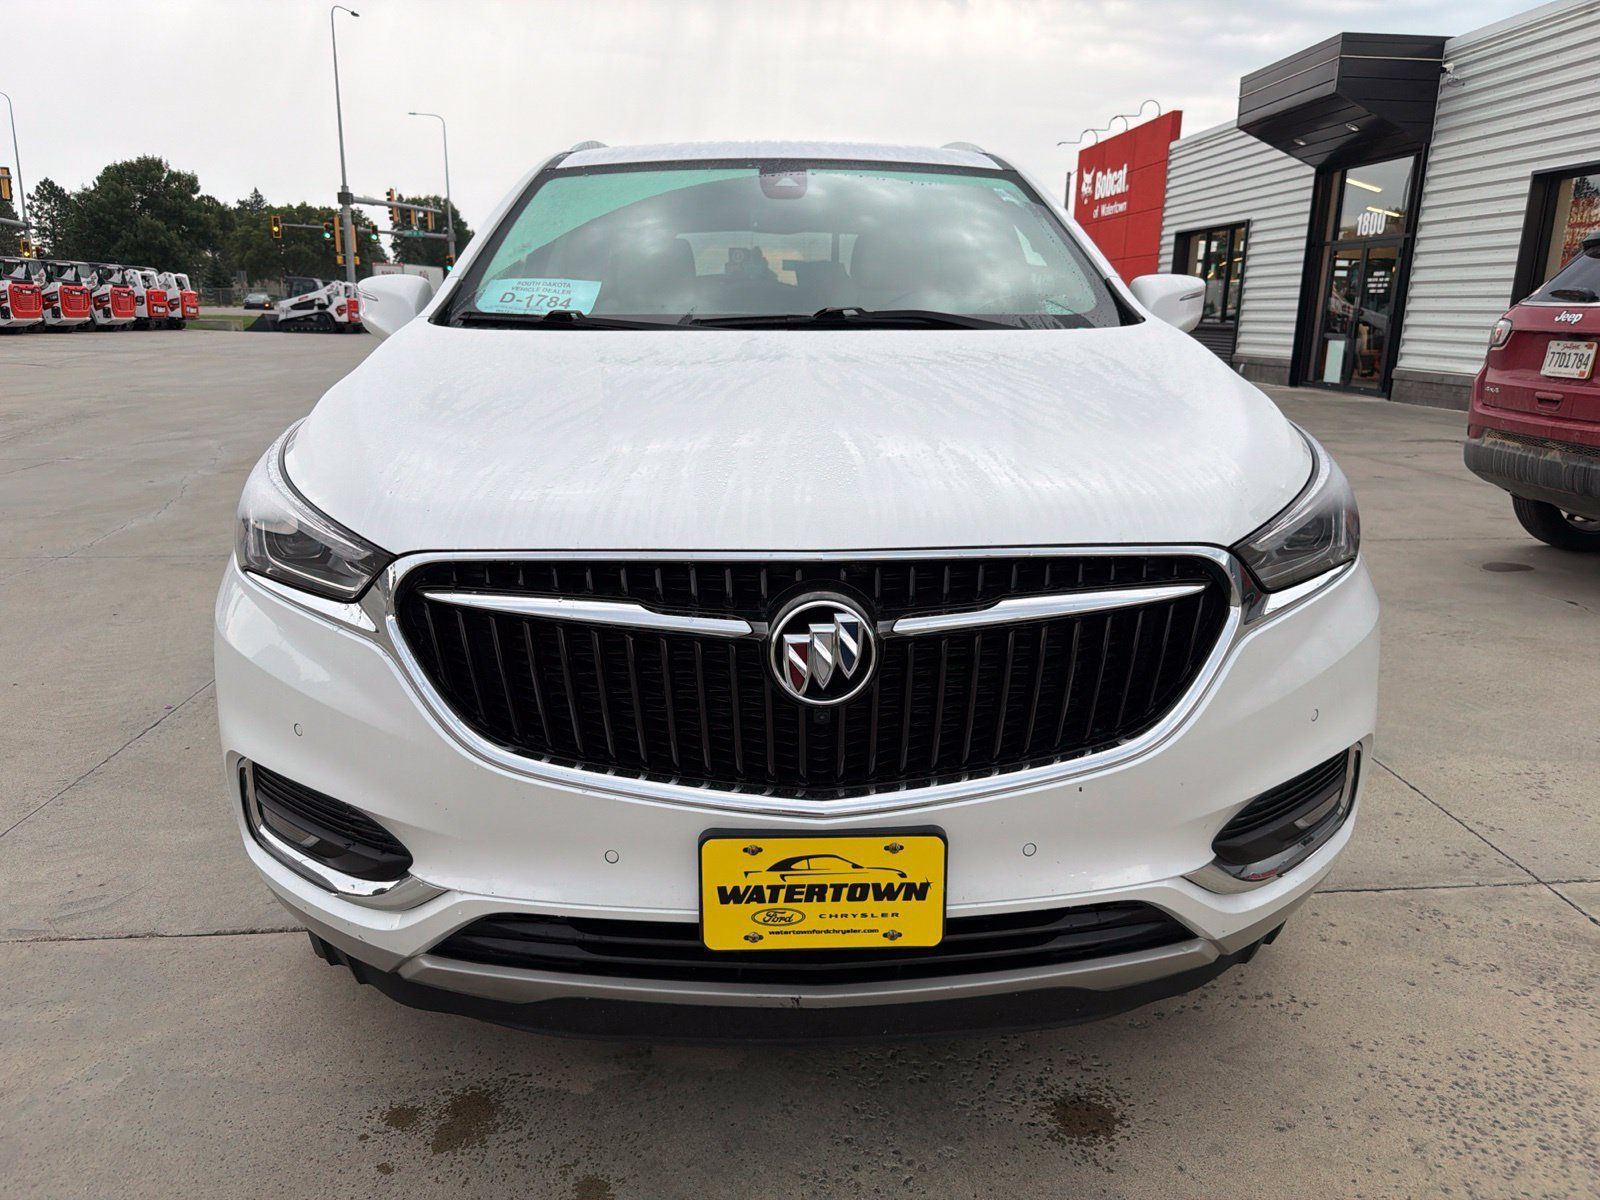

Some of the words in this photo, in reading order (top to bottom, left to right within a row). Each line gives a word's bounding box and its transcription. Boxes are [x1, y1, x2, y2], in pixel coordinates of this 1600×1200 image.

[1094, 163, 1128, 200] Bobcat
[1356, 212, 1386, 237] 1800
[541, 287, 572, 295] DEALER
[499, 292, 572, 309] D-1784
[1554, 311, 1583, 325] Jeep
[1547, 351, 1591, 370] 77D1784
[717, 882, 930, 905] WATERTOWN
[768, 927, 879, 936] watertownfordchrysler.com
